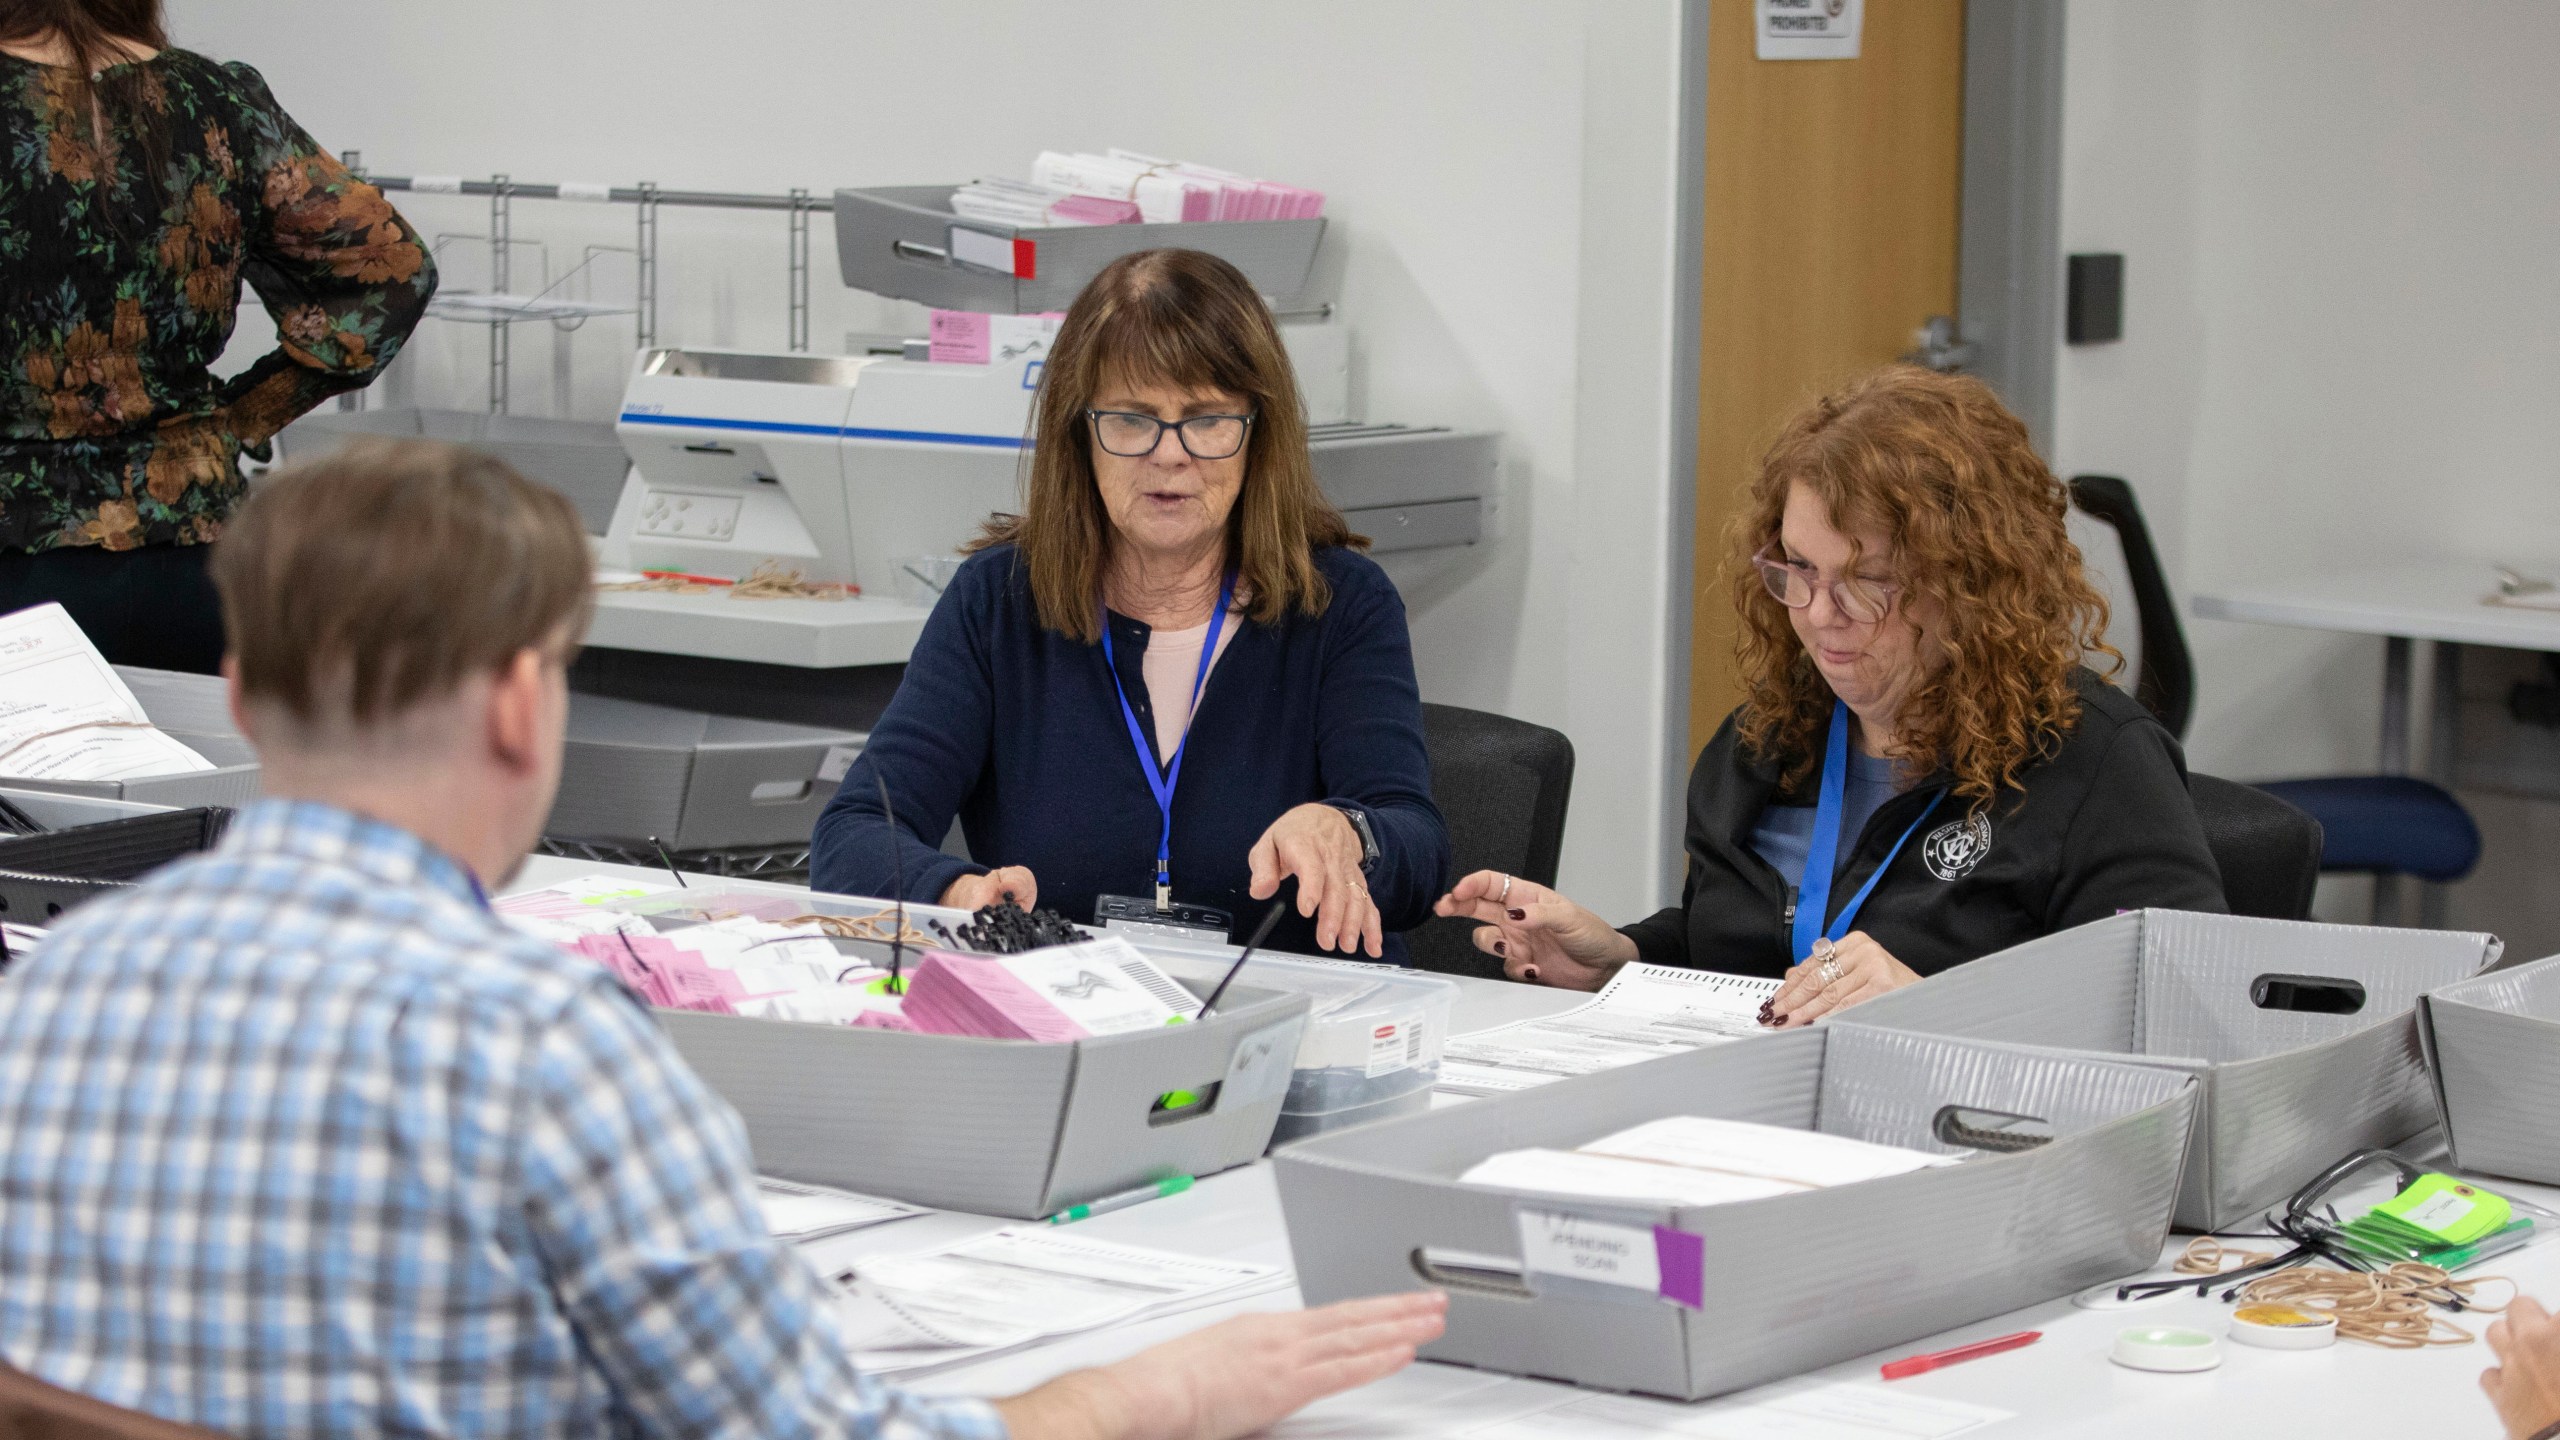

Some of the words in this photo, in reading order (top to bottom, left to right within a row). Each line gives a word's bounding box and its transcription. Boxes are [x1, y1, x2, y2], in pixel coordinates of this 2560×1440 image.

[1931, 823, 1963, 841] WASHOE
[1940, 868, 1957, 878] 1861
[1573, 1253, 1619, 1273] SCAN
